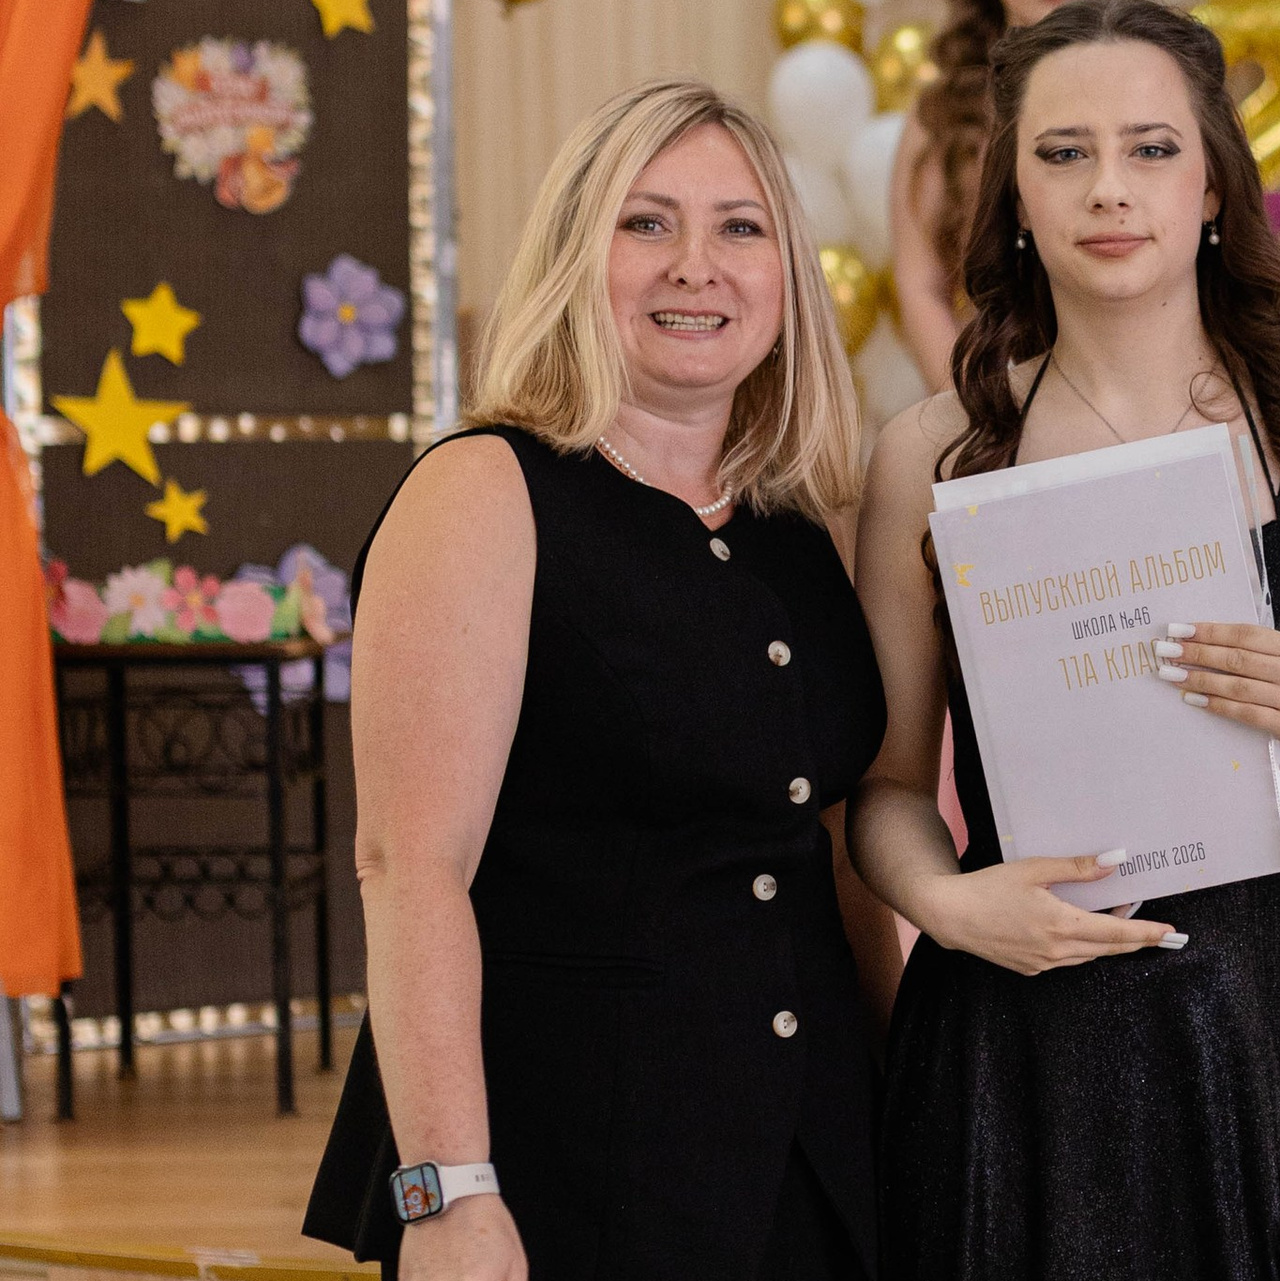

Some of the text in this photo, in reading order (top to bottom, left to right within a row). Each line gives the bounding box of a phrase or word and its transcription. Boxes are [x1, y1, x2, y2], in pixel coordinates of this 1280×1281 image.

[979, 541, 1227, 626] ВЫПУСКНОЙ АЛЬБОМ
[1071, 606, 1152, 640] ШКОЛА №46
[1058, 636, 1180, 691] 11А КЛАС
[1171, 841, 1206, 866] 2026
